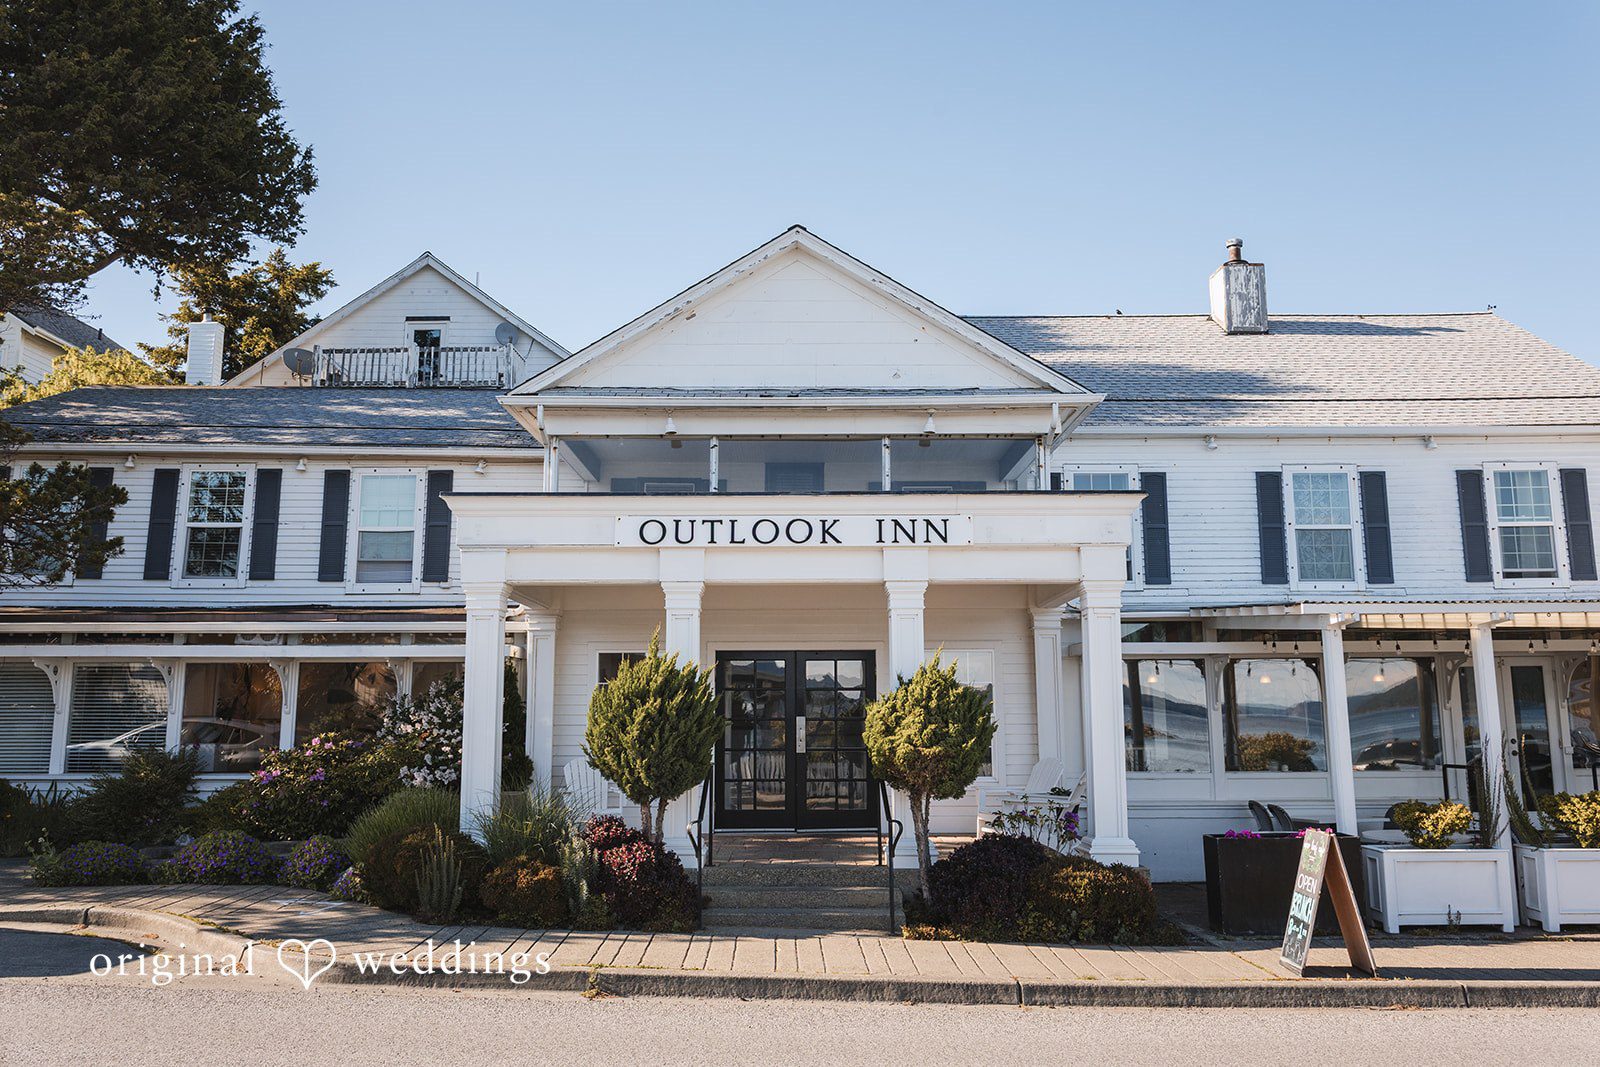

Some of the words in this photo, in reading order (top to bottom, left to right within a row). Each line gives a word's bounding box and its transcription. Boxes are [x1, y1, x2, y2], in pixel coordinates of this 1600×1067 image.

[639, 519, 842, 545] OUTLOOK
[876, 519, 949, 545] INN
[1298, 873, 1317, 894] OPEN
